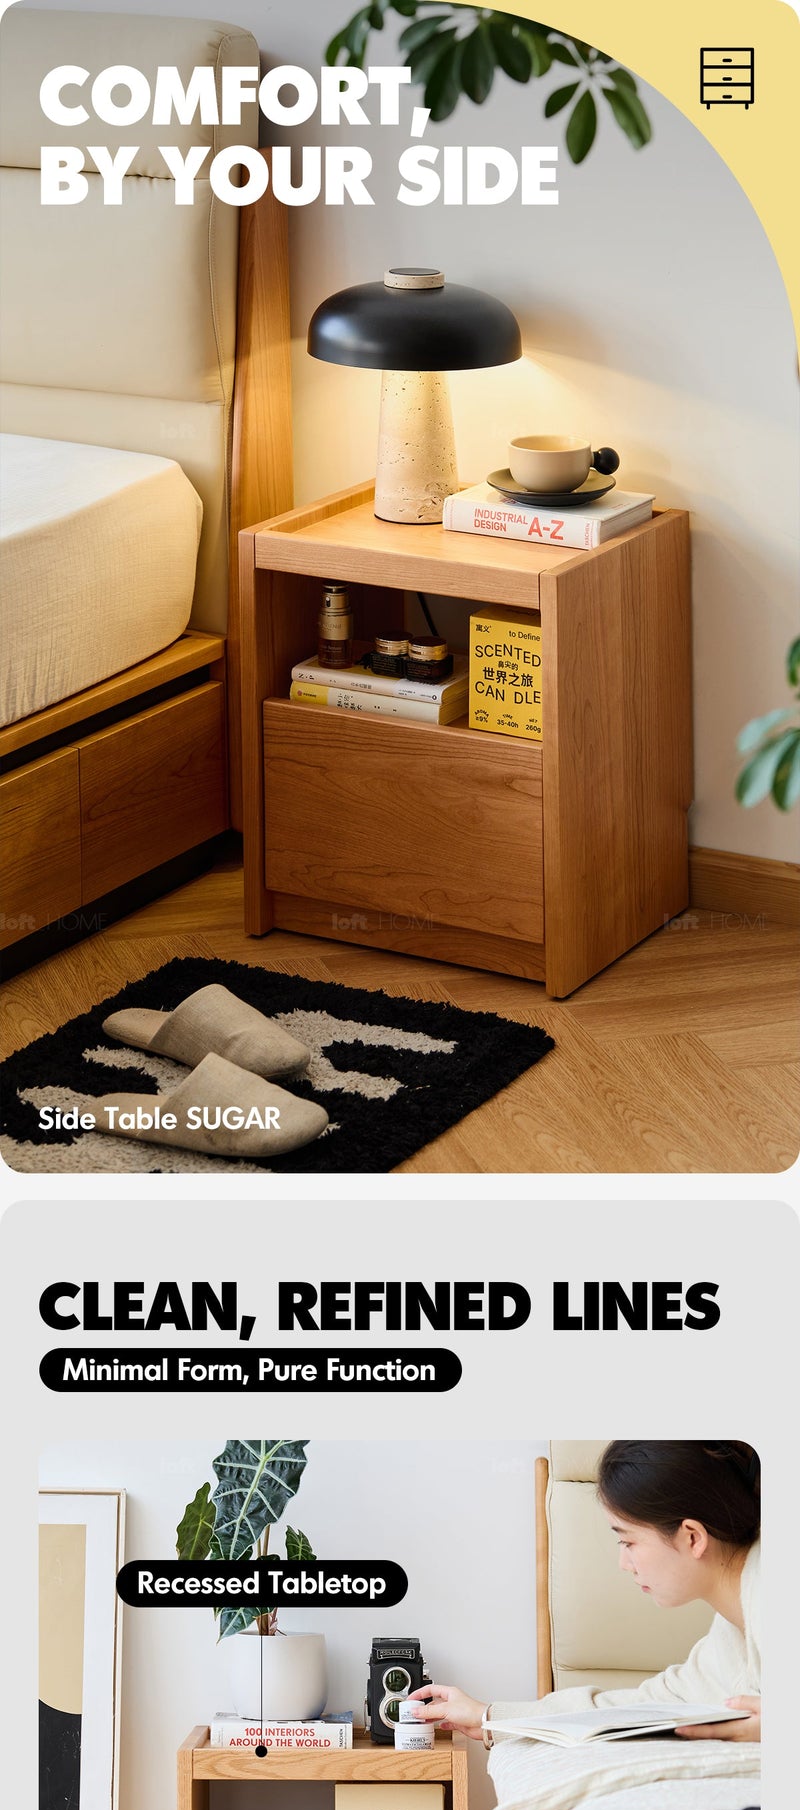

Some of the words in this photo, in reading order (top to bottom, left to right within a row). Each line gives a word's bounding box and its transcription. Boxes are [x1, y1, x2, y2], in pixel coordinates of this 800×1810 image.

[474, 508, 528, 525] INDUSTRIAL
[474, 519, 507, 532] DESIGN
[527, 516, 564, 541] A-Z
[509, 630, 516, 638] to
[518, 631, 541, 641] Define
[475, 643, 541, 667] SCENTED
[483, 666, 533, 688] 世界之旅
[475, 681, 505, 702] CAN
[514, 690, 541, 704] DLE
[497, 719, 519, 729] 35-40h
[245, 1728, 262, 1736] 100
[265, 1728, 315, 1737] INTERIORS
[230, 1738, 272, 1747] AROUND
[275, 1738, 293, 1747] THE
[296, 1738, 331, 1747] WORLD
